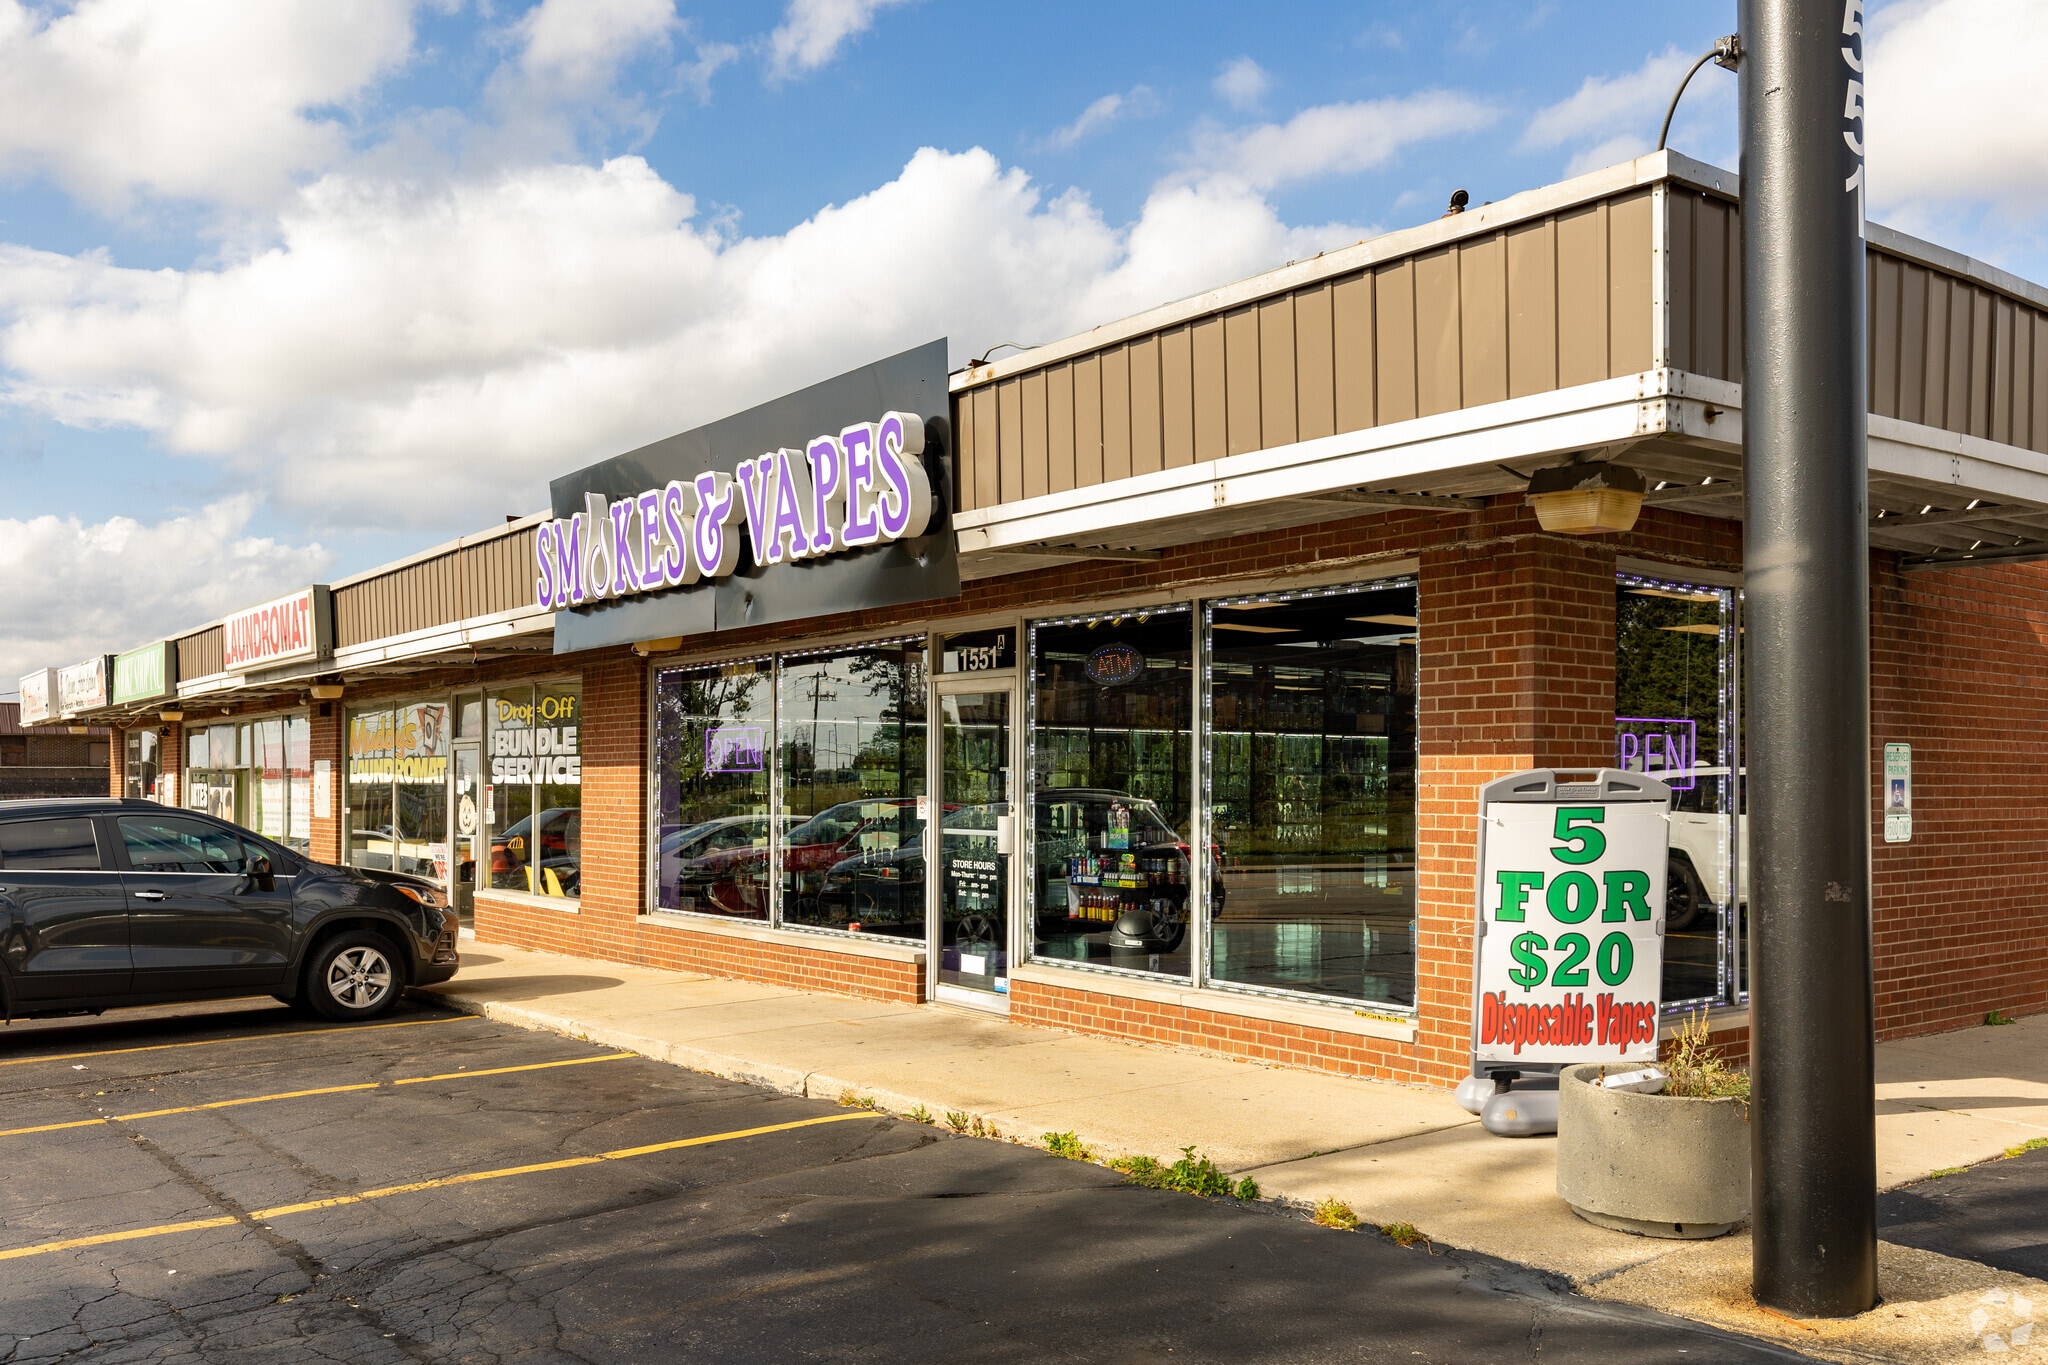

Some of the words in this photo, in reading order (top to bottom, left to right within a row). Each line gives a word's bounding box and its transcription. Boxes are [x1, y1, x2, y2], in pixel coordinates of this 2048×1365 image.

[536, 478, 690, 612] SMOKES
[694, 471, 735, 578] &
[736, 410, 917, 568] VAPES
[223, 597, 308, 665] LAUNDROMAT
[960, 645, 997, 671] 1551
[997, 634, 1005, 650] A
[1097, 651, 1133, 677] ATM
[496, 696, 576, 726] Drop-Off
[350, 708, 417, 760] Muddy's
[494, 726, 577, 757] BUNDLE
[710, 738, 759, 766] OPEN
[1620, 733, 1686, 779] PEN
[1886, 751, 1909, 762] RESERVED
[349, 755, 447, 784] LAUNDROMAT
[492, 755, 581, 785] SERVICE
[1888, 765, 1908, 775] PARKING
[1549, 806, 1606, 865] 5
[1899, 820, 1910, 836] FINE
[952, 859, 973, 869] STORE
[973, 860, 996, 871] HOURS
[1495, 870, 1652, 924] FOR
[1508, 930, 1634, 992] $20
[1481, 991, 1594, 1055] Disposable
[1597, 992, 1656, 1055] Vapes
